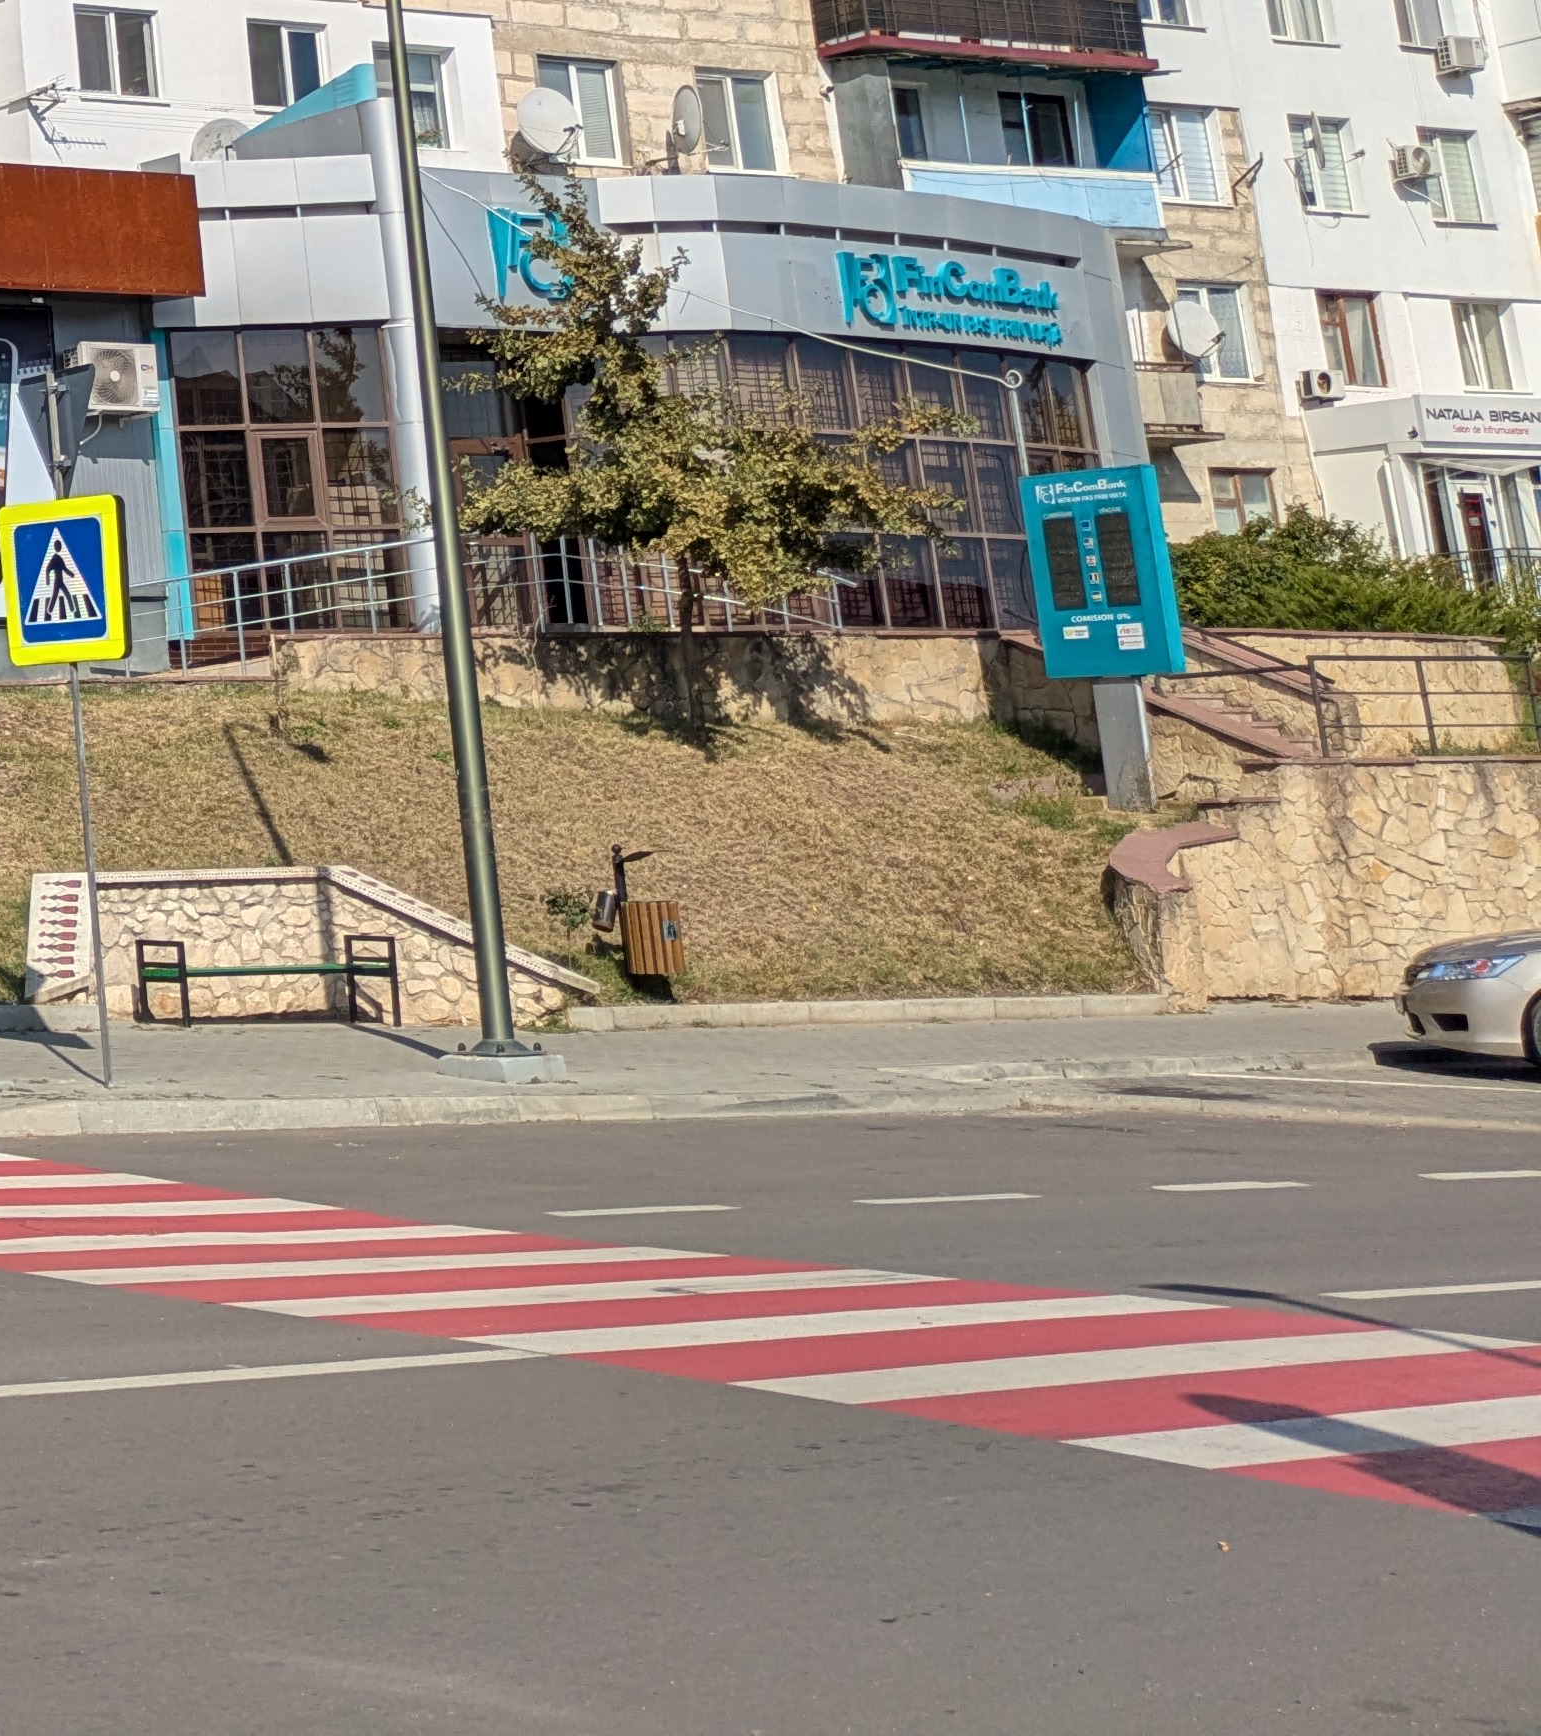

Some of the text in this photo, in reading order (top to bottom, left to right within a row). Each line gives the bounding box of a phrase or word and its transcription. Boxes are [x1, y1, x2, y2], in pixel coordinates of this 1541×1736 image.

[891, 255, 1059, 310] FinComBank
[1425, 407, 1484, 421] NATALIA
[1453, 425, 1470, 433] Salon
[1472, 425, 1481, 434] de
[1055, 478, 1127, 494] FinComBank
[1117, 613, 1131, 621] 0%
